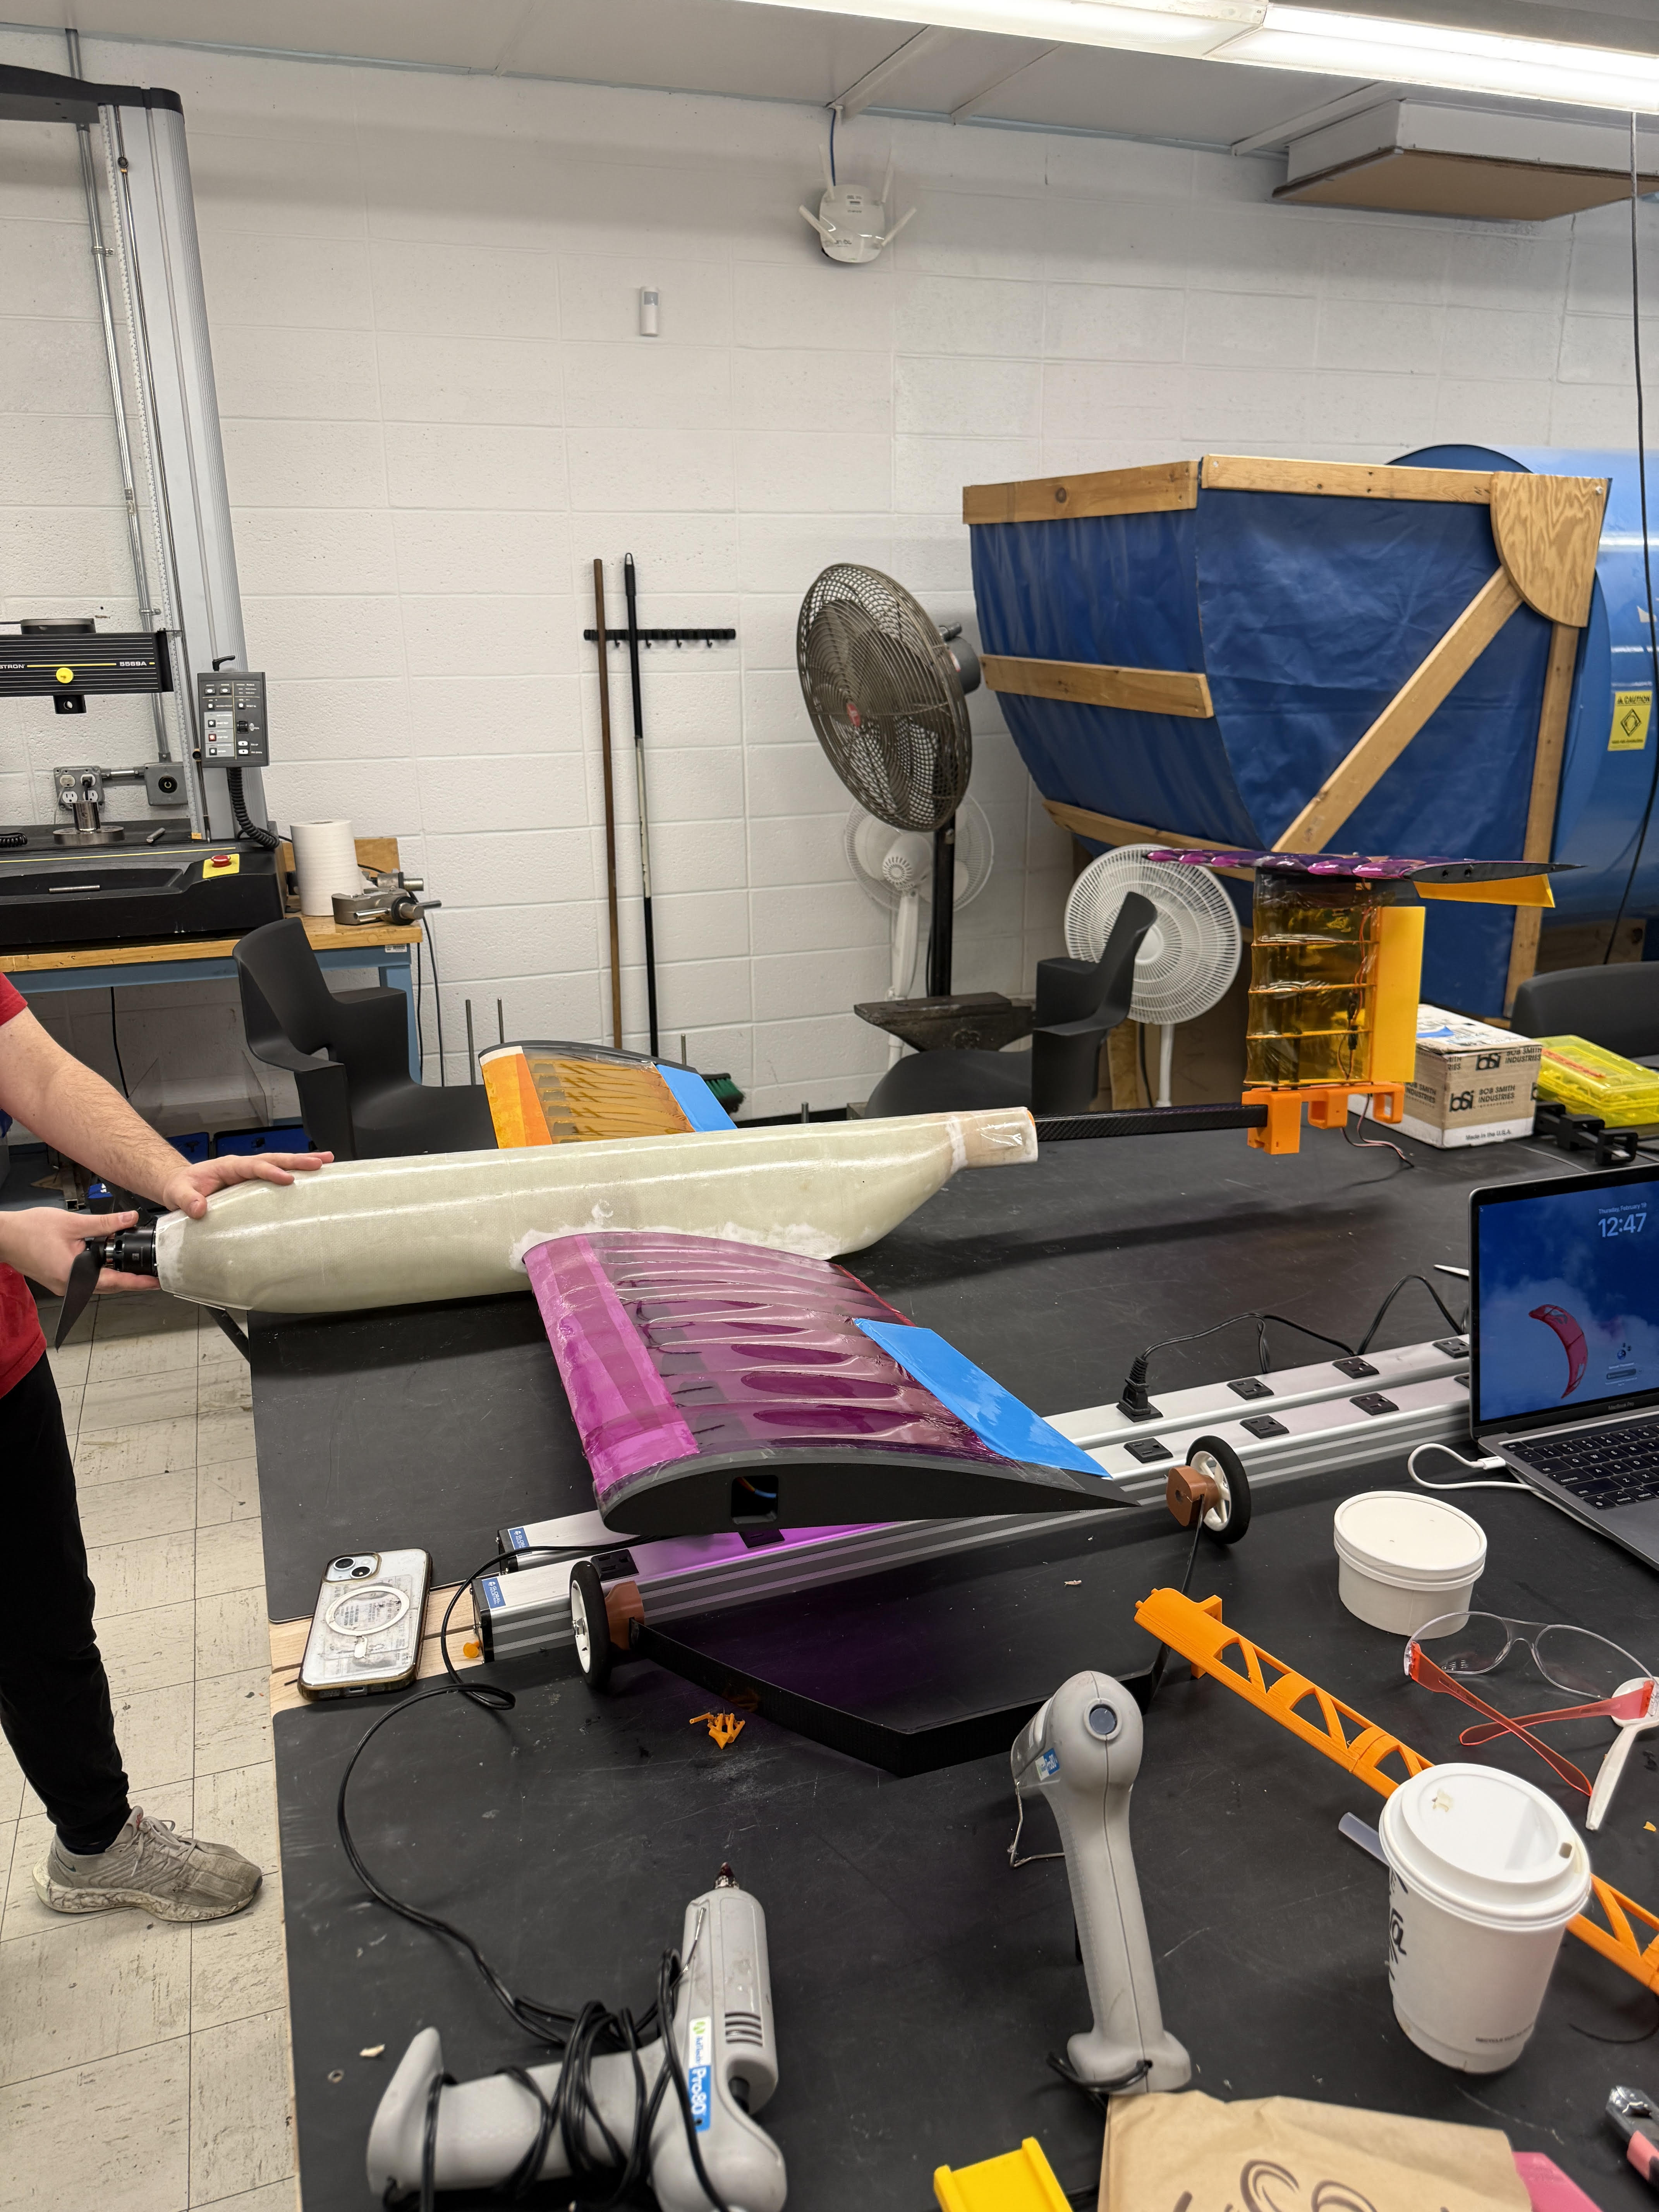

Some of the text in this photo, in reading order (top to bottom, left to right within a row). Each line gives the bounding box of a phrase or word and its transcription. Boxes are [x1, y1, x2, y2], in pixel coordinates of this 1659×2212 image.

[1624, 695, 1650, 704] CAUTION
[1505, 1054, 1541, 1064] INDUSTRIES
[1419, 1084, 1436, 1095] SMITH
[1495, 1084, 1516, 1093] SMITH
[1478, 1092, 1515, 1103] INDUSTRIES
[1598, 1212, 1647, 1238] 12:47
[493, 1586, 501, 1604] GLOBAL
[691, 2066, 707, 2115] Pro80
